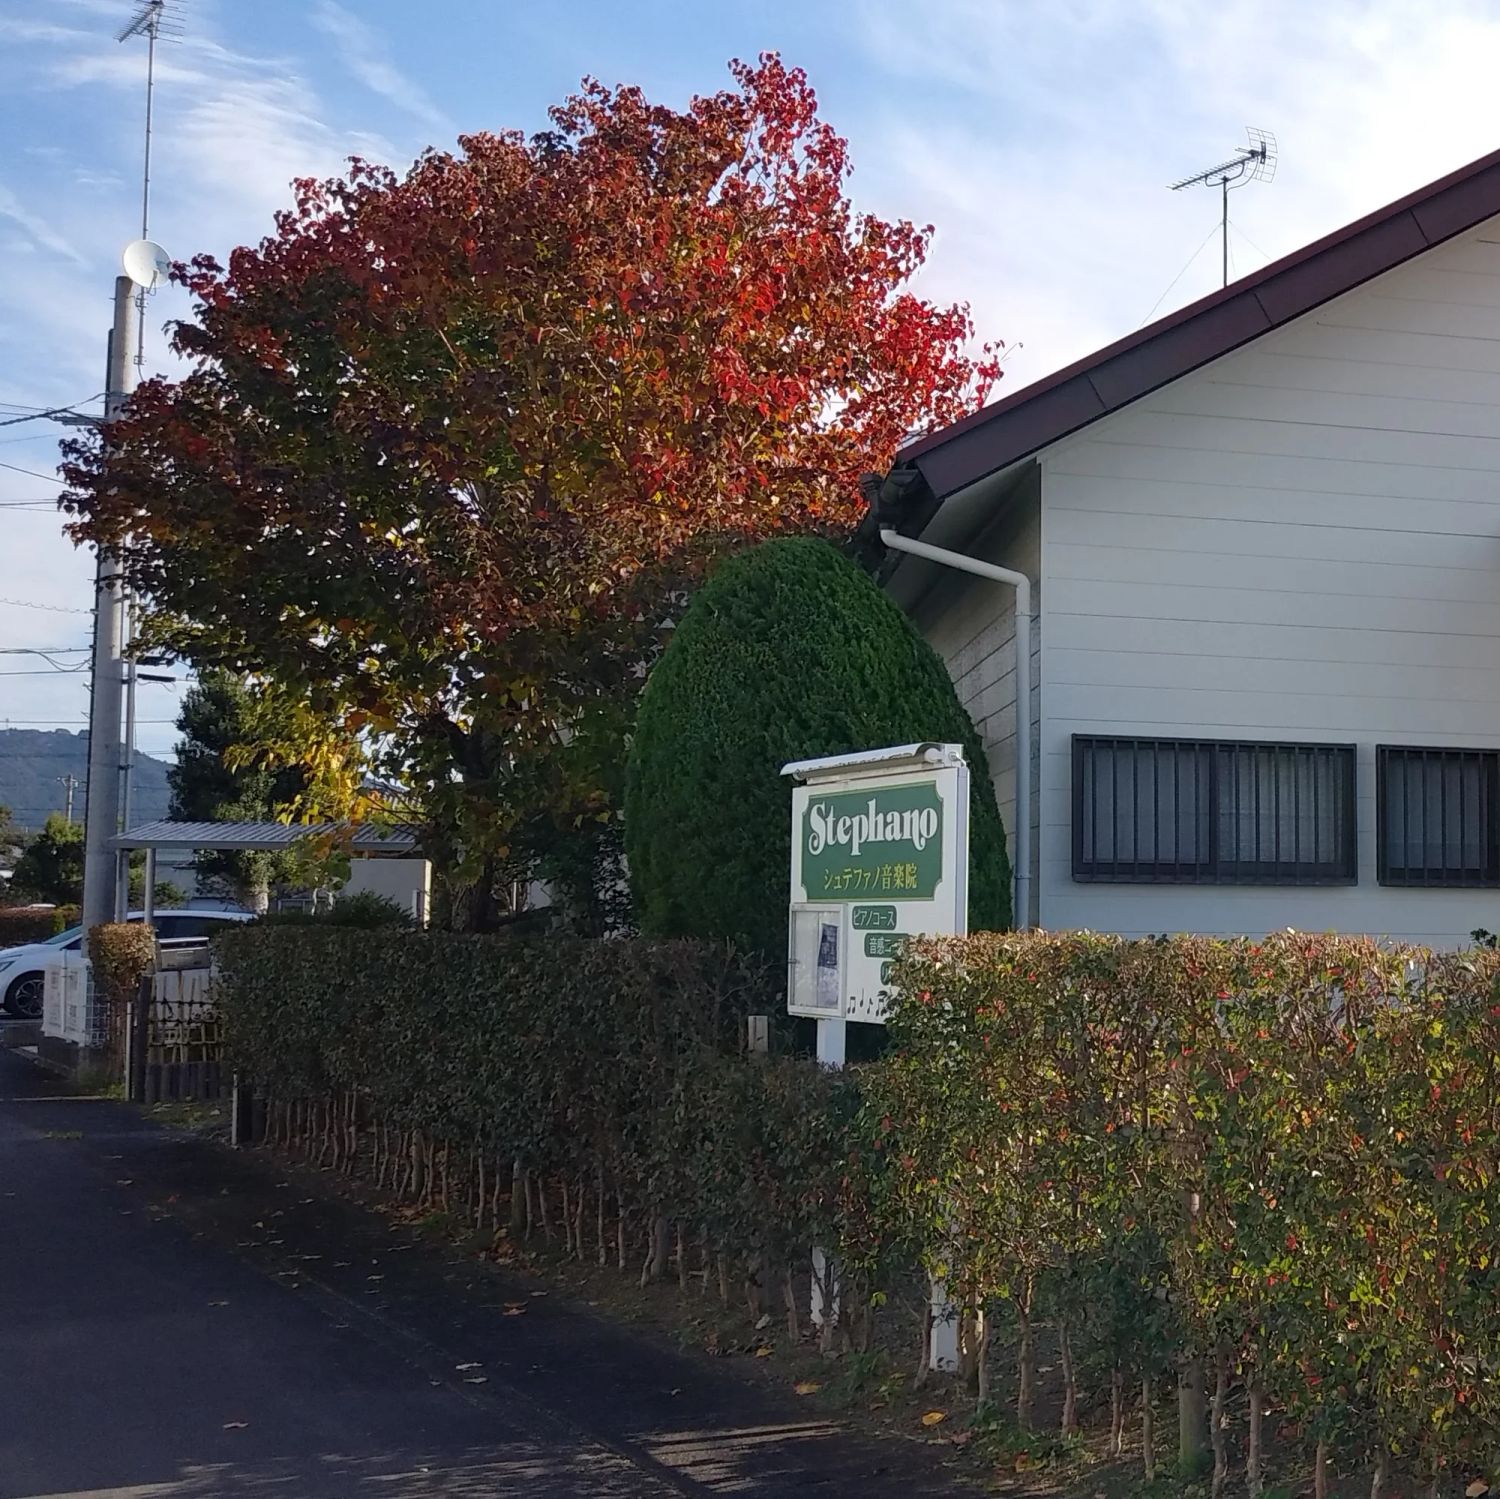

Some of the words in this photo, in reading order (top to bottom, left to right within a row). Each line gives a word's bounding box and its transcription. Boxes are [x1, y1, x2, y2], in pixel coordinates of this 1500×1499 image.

[808, 798, 938, 856] Stephano
[824, 863, 918, 891] シュテファノ音楽院
[853, 910, 895, 926] ピアノコース
